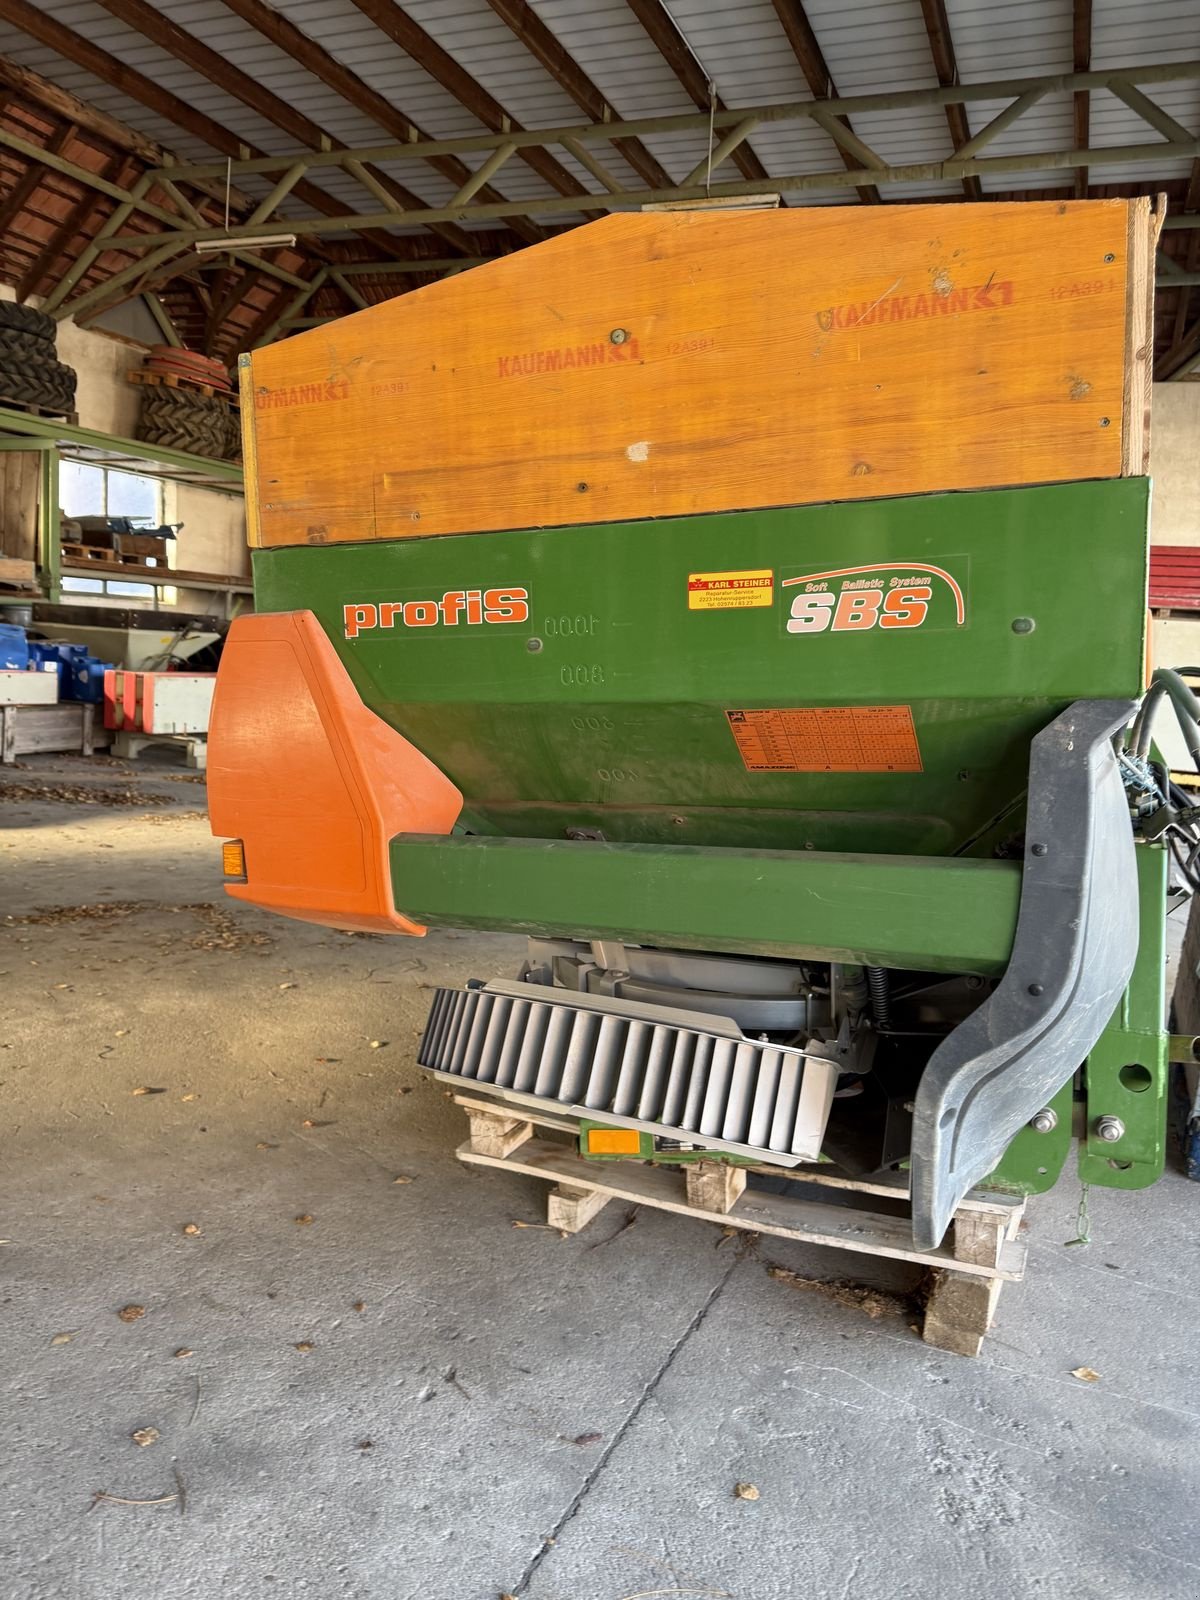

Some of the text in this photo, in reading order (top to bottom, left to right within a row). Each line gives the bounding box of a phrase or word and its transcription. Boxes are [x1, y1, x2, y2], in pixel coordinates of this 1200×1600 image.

[831, 288, 969, 328] KAUFMANN
[498, 344, 605, 378] KAUFMANN
[733, 579, 771, 588] STEINER
[804, 576, 932, 593] Soft Ballistic System
[343, 587, 529, 640] profiS
[786, 586, 933, 634] SBS
